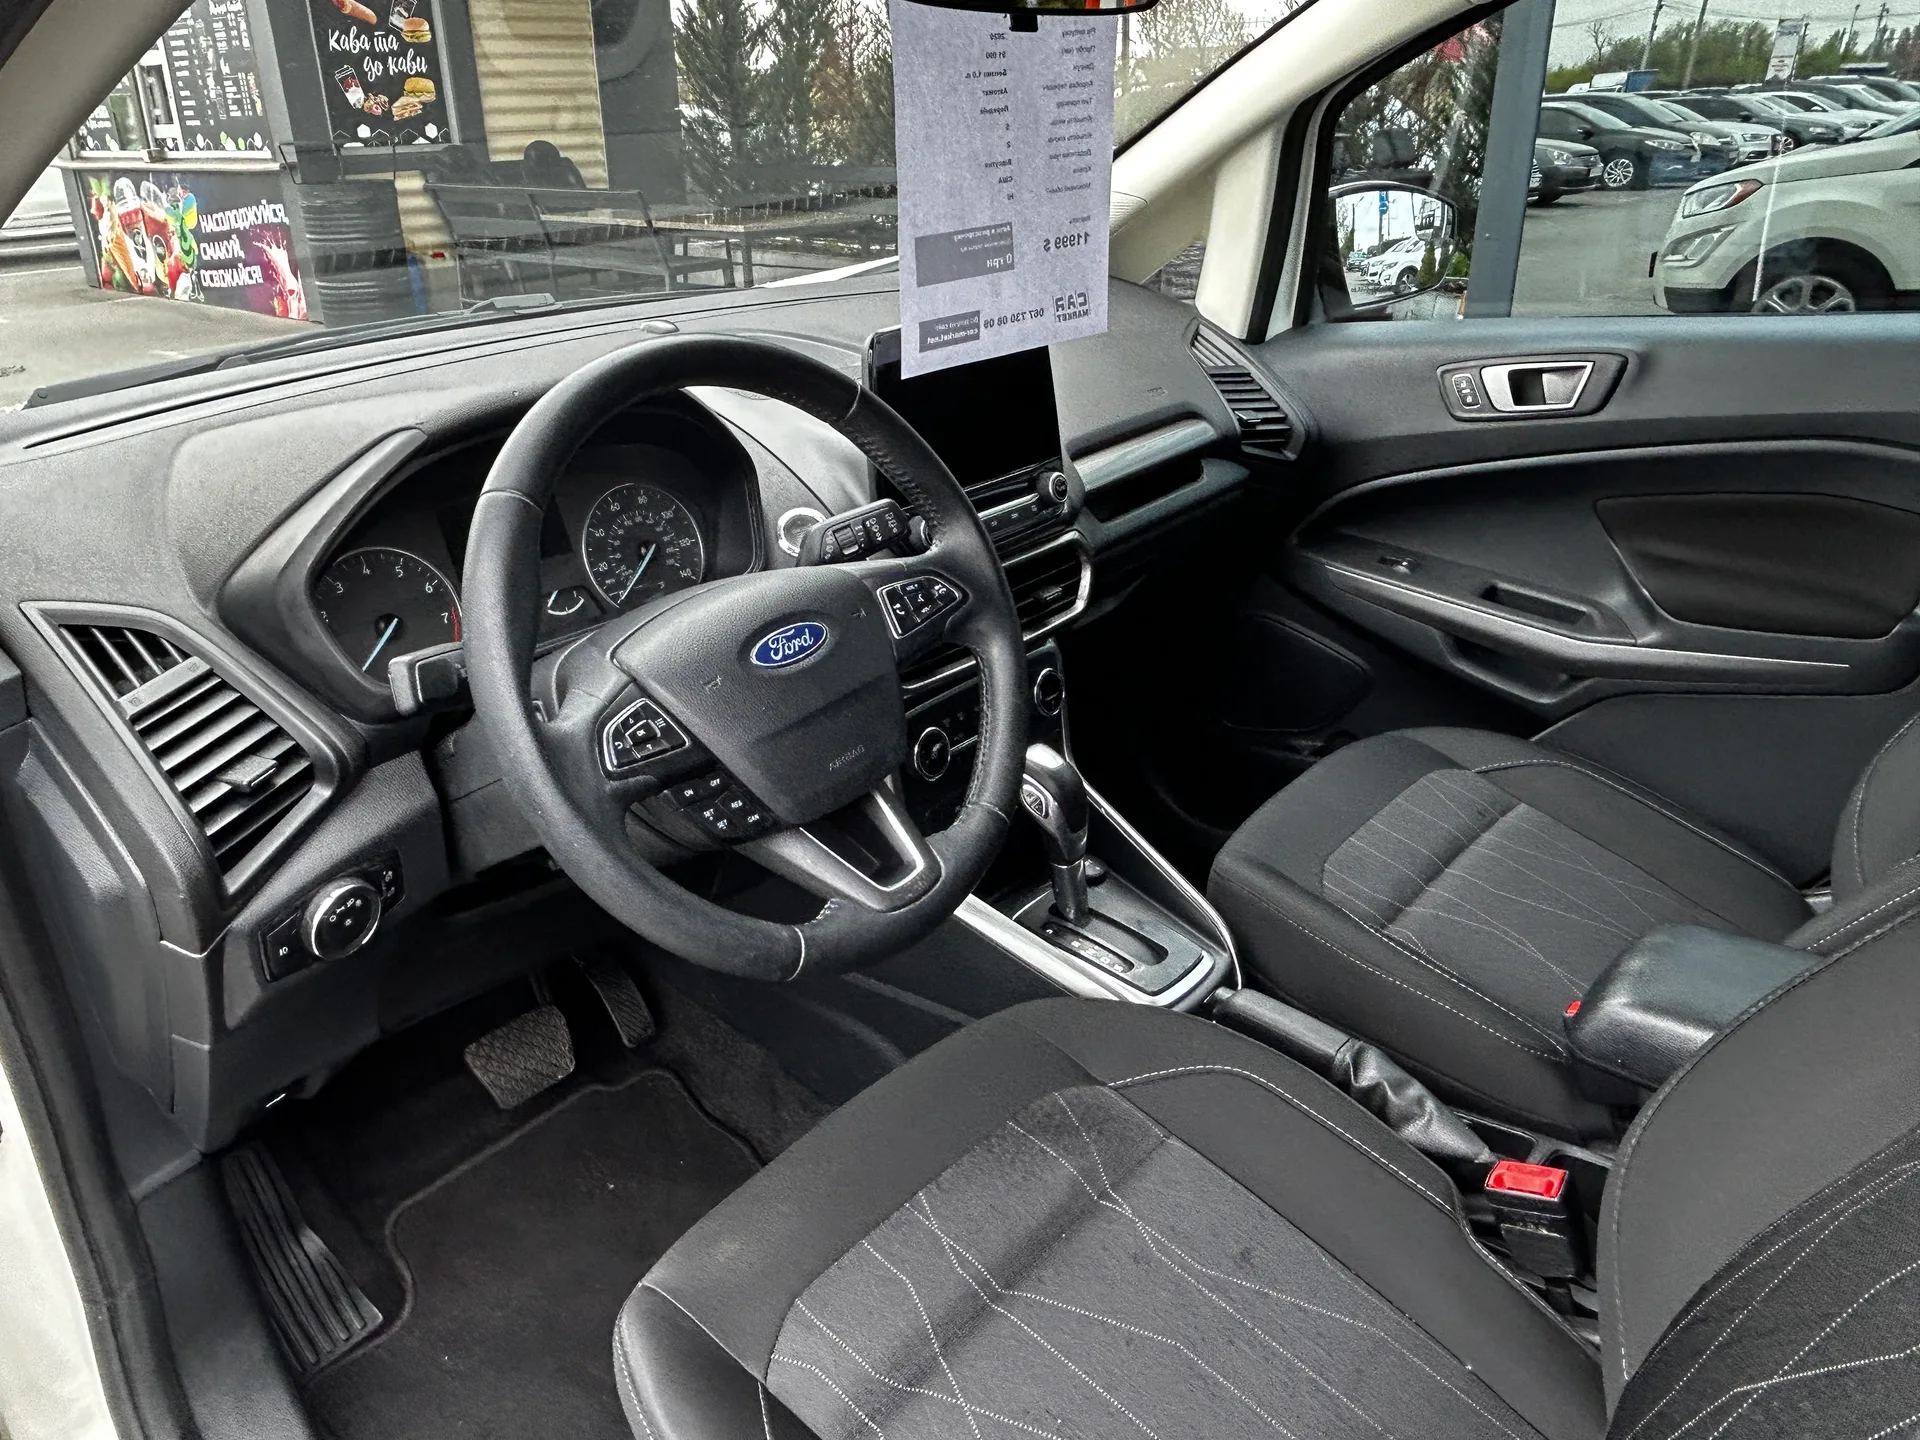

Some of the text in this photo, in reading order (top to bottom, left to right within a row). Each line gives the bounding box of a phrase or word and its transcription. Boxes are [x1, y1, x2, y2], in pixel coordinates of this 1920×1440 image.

[328, 26, 399, 53] Кава та
[363, 48, 427, 81] до кави
[199, 200, 289, 233] НАСОЛОДЖУЙСЯ,
[200, 234, 245, 260] СМАКУЙ,
[200, 263, 263, 287] ОСВІЖАЙСЯ!
[395, 566, 403, 577] 5
[334, 582, 344, 593] 3
[425, 582, 433, 593] 6
[441, 612, 448, 623] 7
[768, 628, 814, 661] Ford
[710, 778, 720, 787] OFF
[684, 789, 694, 797] ON
